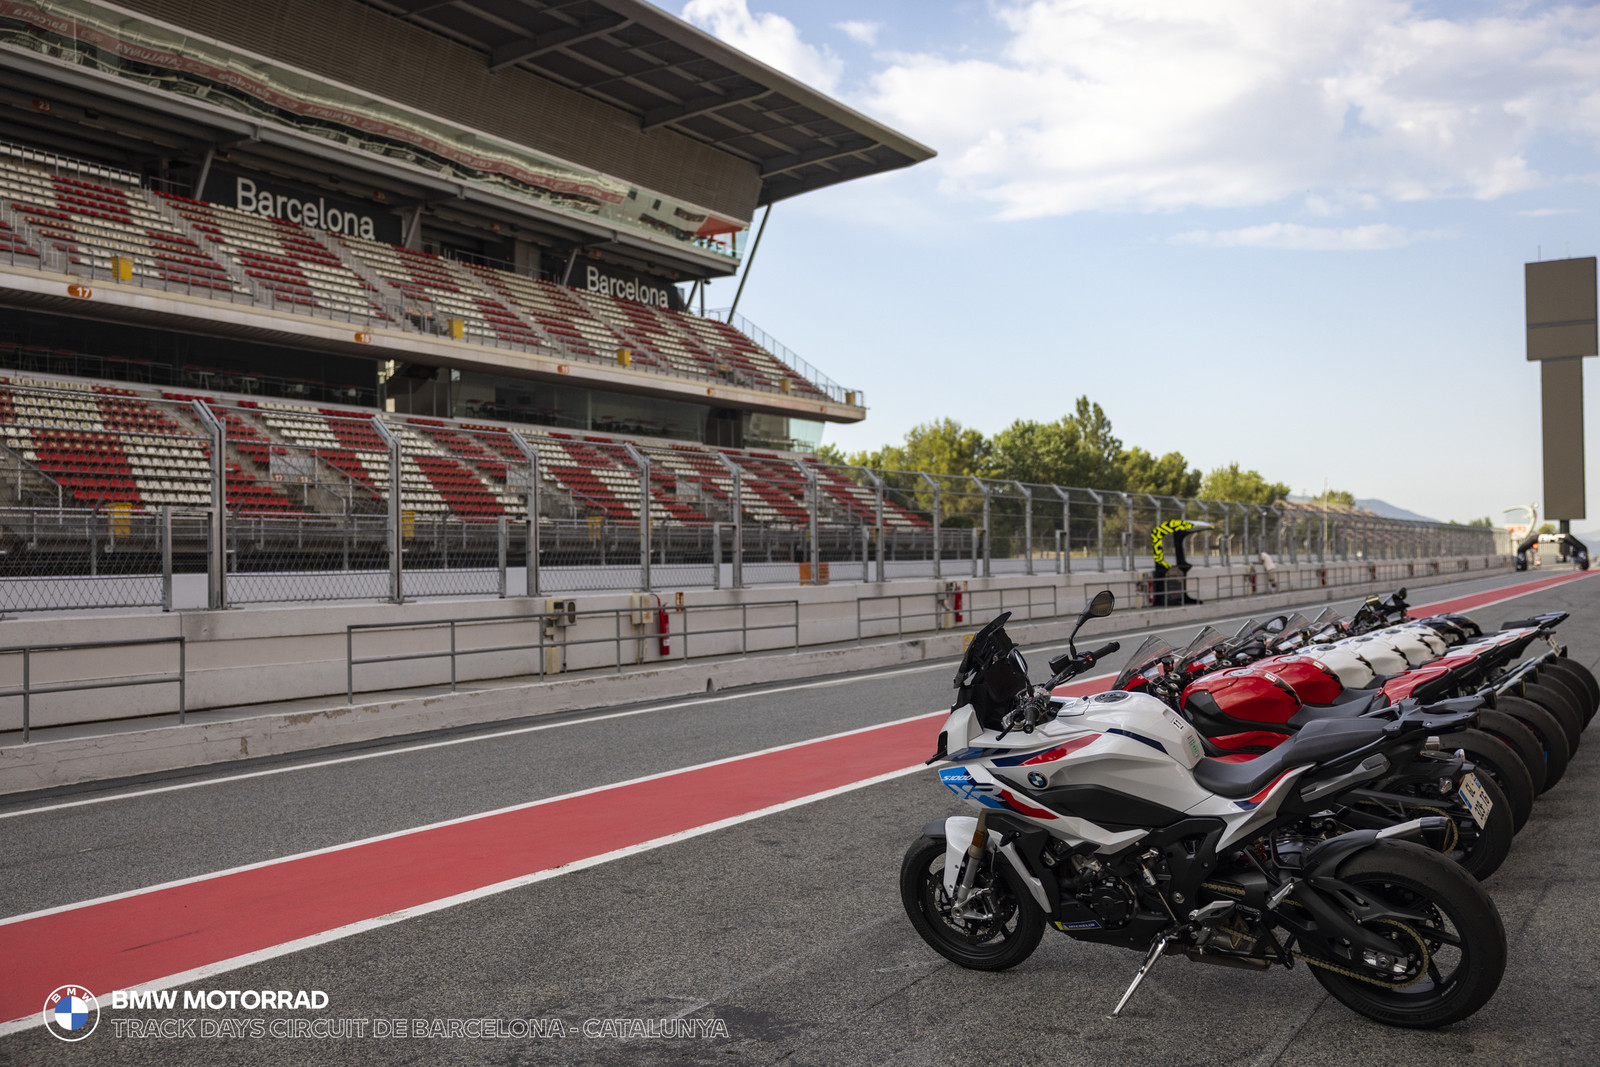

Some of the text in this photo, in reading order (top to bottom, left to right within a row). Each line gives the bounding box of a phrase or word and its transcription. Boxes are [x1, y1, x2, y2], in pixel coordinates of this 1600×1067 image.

[237, 176, 375, 240] Barcelona
[77, 287, 91, 298] 17
[587, 265, 669, 308] Barcelona
